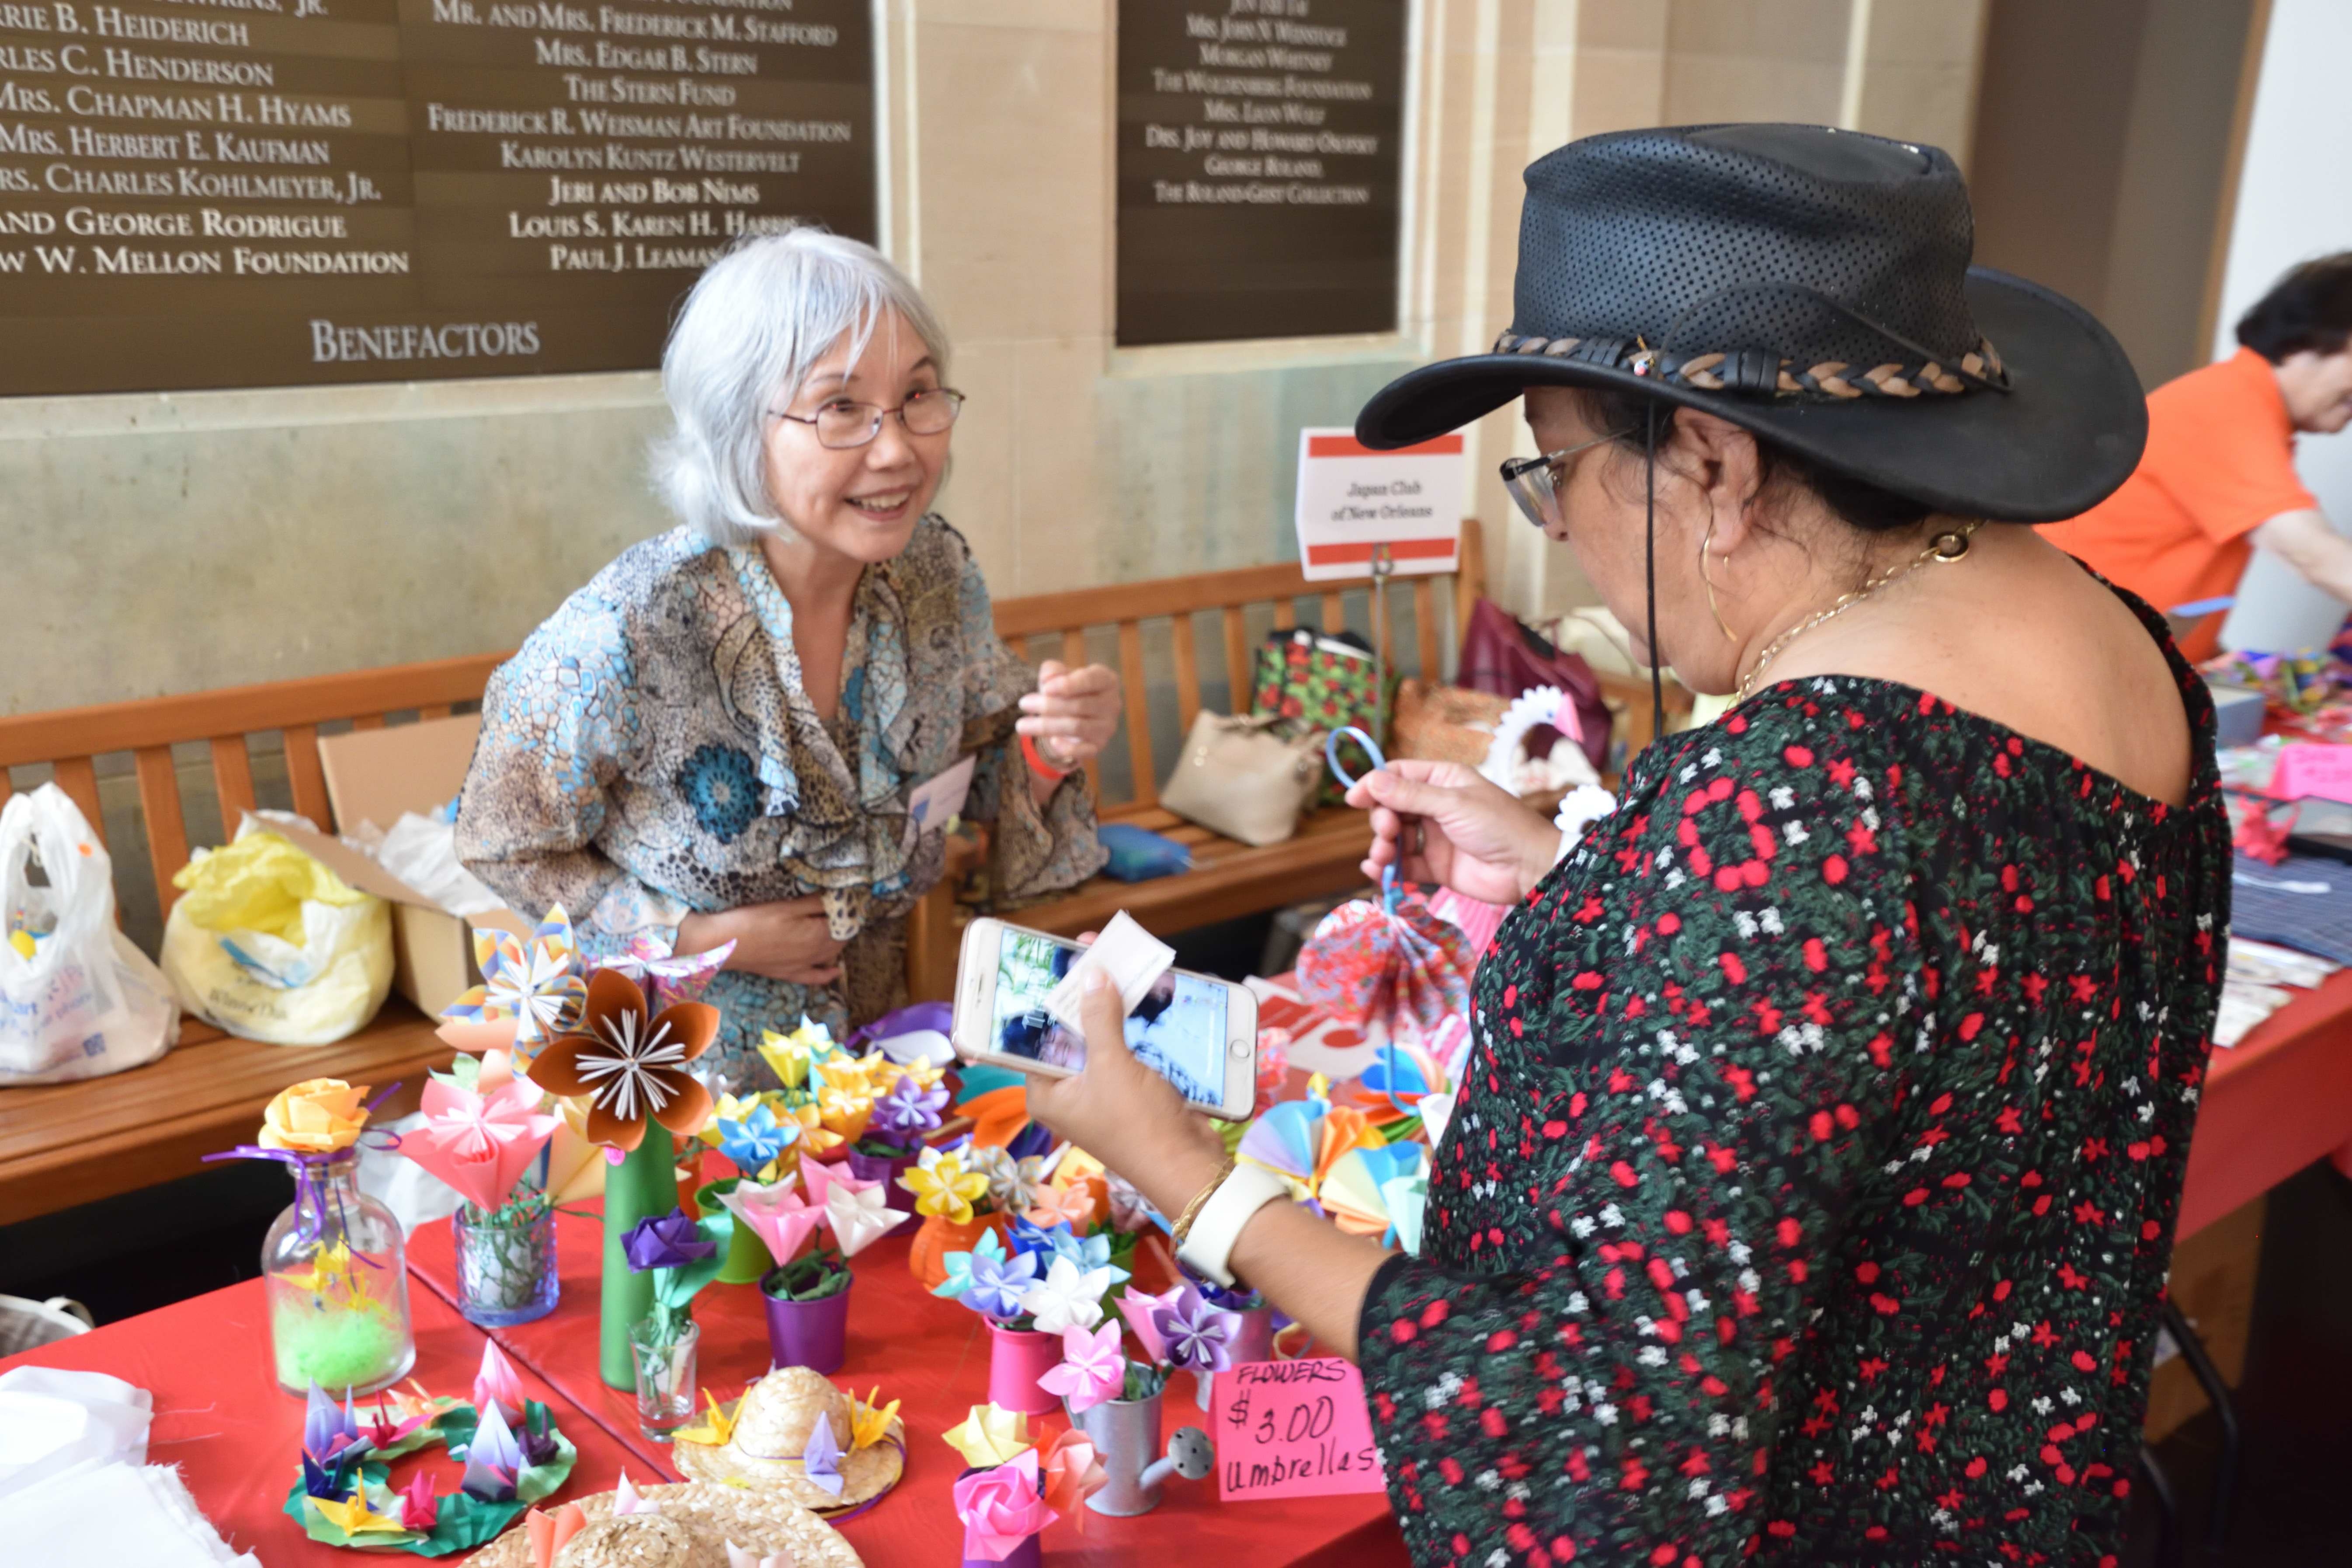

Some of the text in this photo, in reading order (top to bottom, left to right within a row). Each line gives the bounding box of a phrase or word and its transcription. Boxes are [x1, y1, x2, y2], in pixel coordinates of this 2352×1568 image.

[53, 2, 89, 35] B.
[93, 4, 249, 46] HEIDERICH
[433, 0, 839, 47] MR. AND MRS. FREDERICK M. STAFFORD
[60, 44, 99, 76] C.
[104, 47, 274, 86] HENDERSON
[534, 37, 758, 75] MRS. EDGAR B. STERN
[66, 84, 213, 122] CHAPMAN
[217, 93, 254, 124] H.
[260, 95, 351, 128] HYAMS
[563, 73, 737, 106] THE STERN FUND
[427, 103, 851, 143] FREDERICK R. WEISMAN ART FOUNDATION
[69, 125, 181, 160] HERBERT
[186, 132, 211, 161] E.
[215, 132, 330, 165] KAUFMAN
[500, 141, 802, 173] KAROLYN KUNTZ WESTERVELT
[45, 162, 174, 196] CHARLES
[177, 167, 343, 203] KOHLMEYER,
[346, 171, 382, 205] JR.
[549, 175, 761, 207] JERI AND BOB NIMS
[65, 206, 195, 236] GEORGE
[200, 207, 348, 238] RODRIGUE
[509, 212, 580, 237] LOUIS
[583, 212, 607, 237] S.
[612, 211, 685, 236] KAREN
[688, 210, 719, 236] H.
[33, 246, 86, 274] W.
[91, 246, 221, 274] MELLON
[233, 246, 410, 275] FOUNDATION
[550, 245, 610, 271] PAUL
[611, 245, 631, 273] J.
[309, 320, 540, 362] BENEFACTORS
[1347, 480, 1422, 500] Japan Club
[1346, 505, 1377, 520] New
[1379, 504, 1434, 519] Orleans
[1237, 1359, 1347, 1385] FLOWERS
